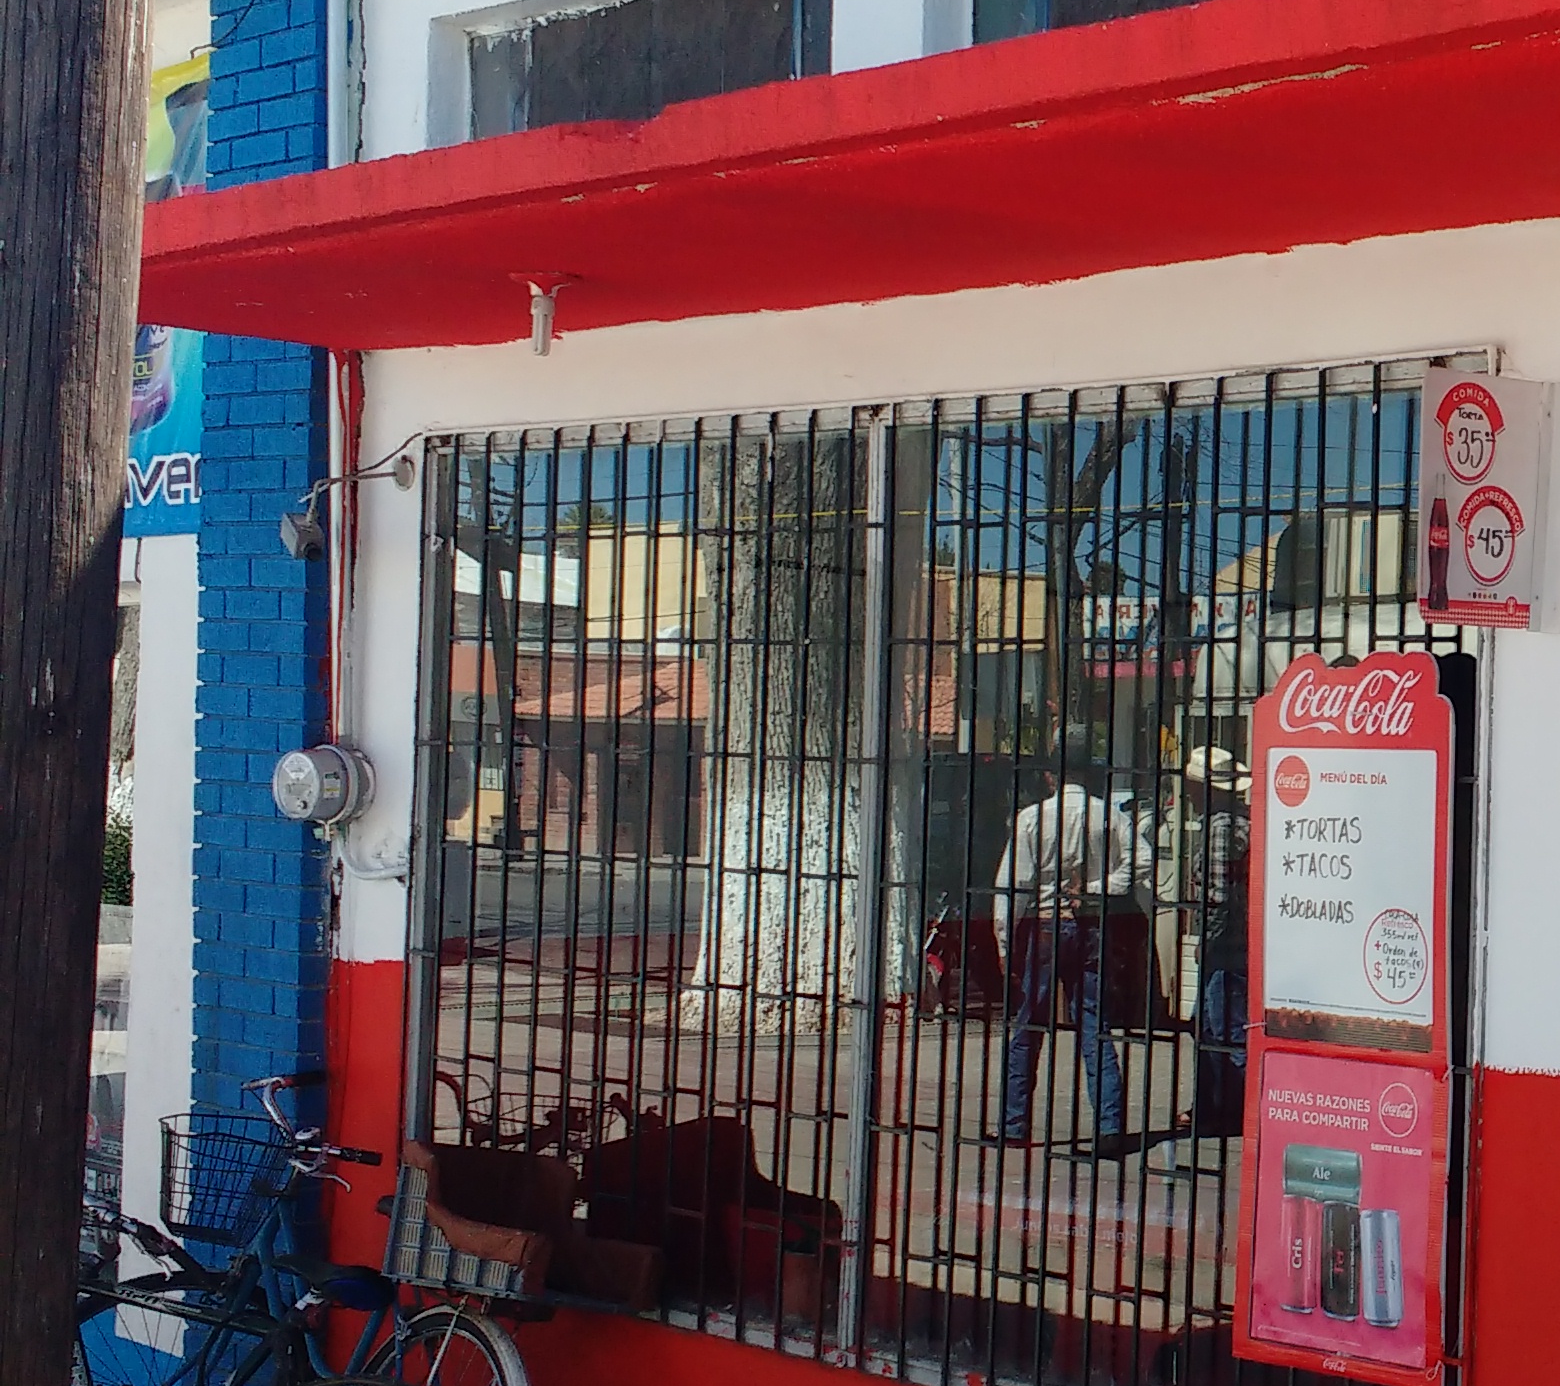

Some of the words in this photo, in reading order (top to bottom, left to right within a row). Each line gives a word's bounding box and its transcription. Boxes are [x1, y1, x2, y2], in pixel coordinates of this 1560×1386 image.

[1453, 387, 1490, 407] COMIDA
[1279, 668, 1422, 736] Coca-Cola
[1320, 770, 1348, 784] MENÚ
[1350, 773, 1368, 785] DEL
[1371, 771, 1388, 785] DÍA
[1383, 942, 1406, 958] Orden
[1409, 946, 1418, 958] de
[1268, 1089, 1314, 1106] NUEVAS
[1316, 1094, 1371, 1113] RAZONES
[1381, 1101, 1414, 1119] Coca-Cola
[1268, 1107, 1299, 1123] PARA
[1302, 1111, 1369, 1131] COMPARTIR
[1312, 1166, 1331, 1181] Ale
[1291, 1238, 1303, 1269] Cris
